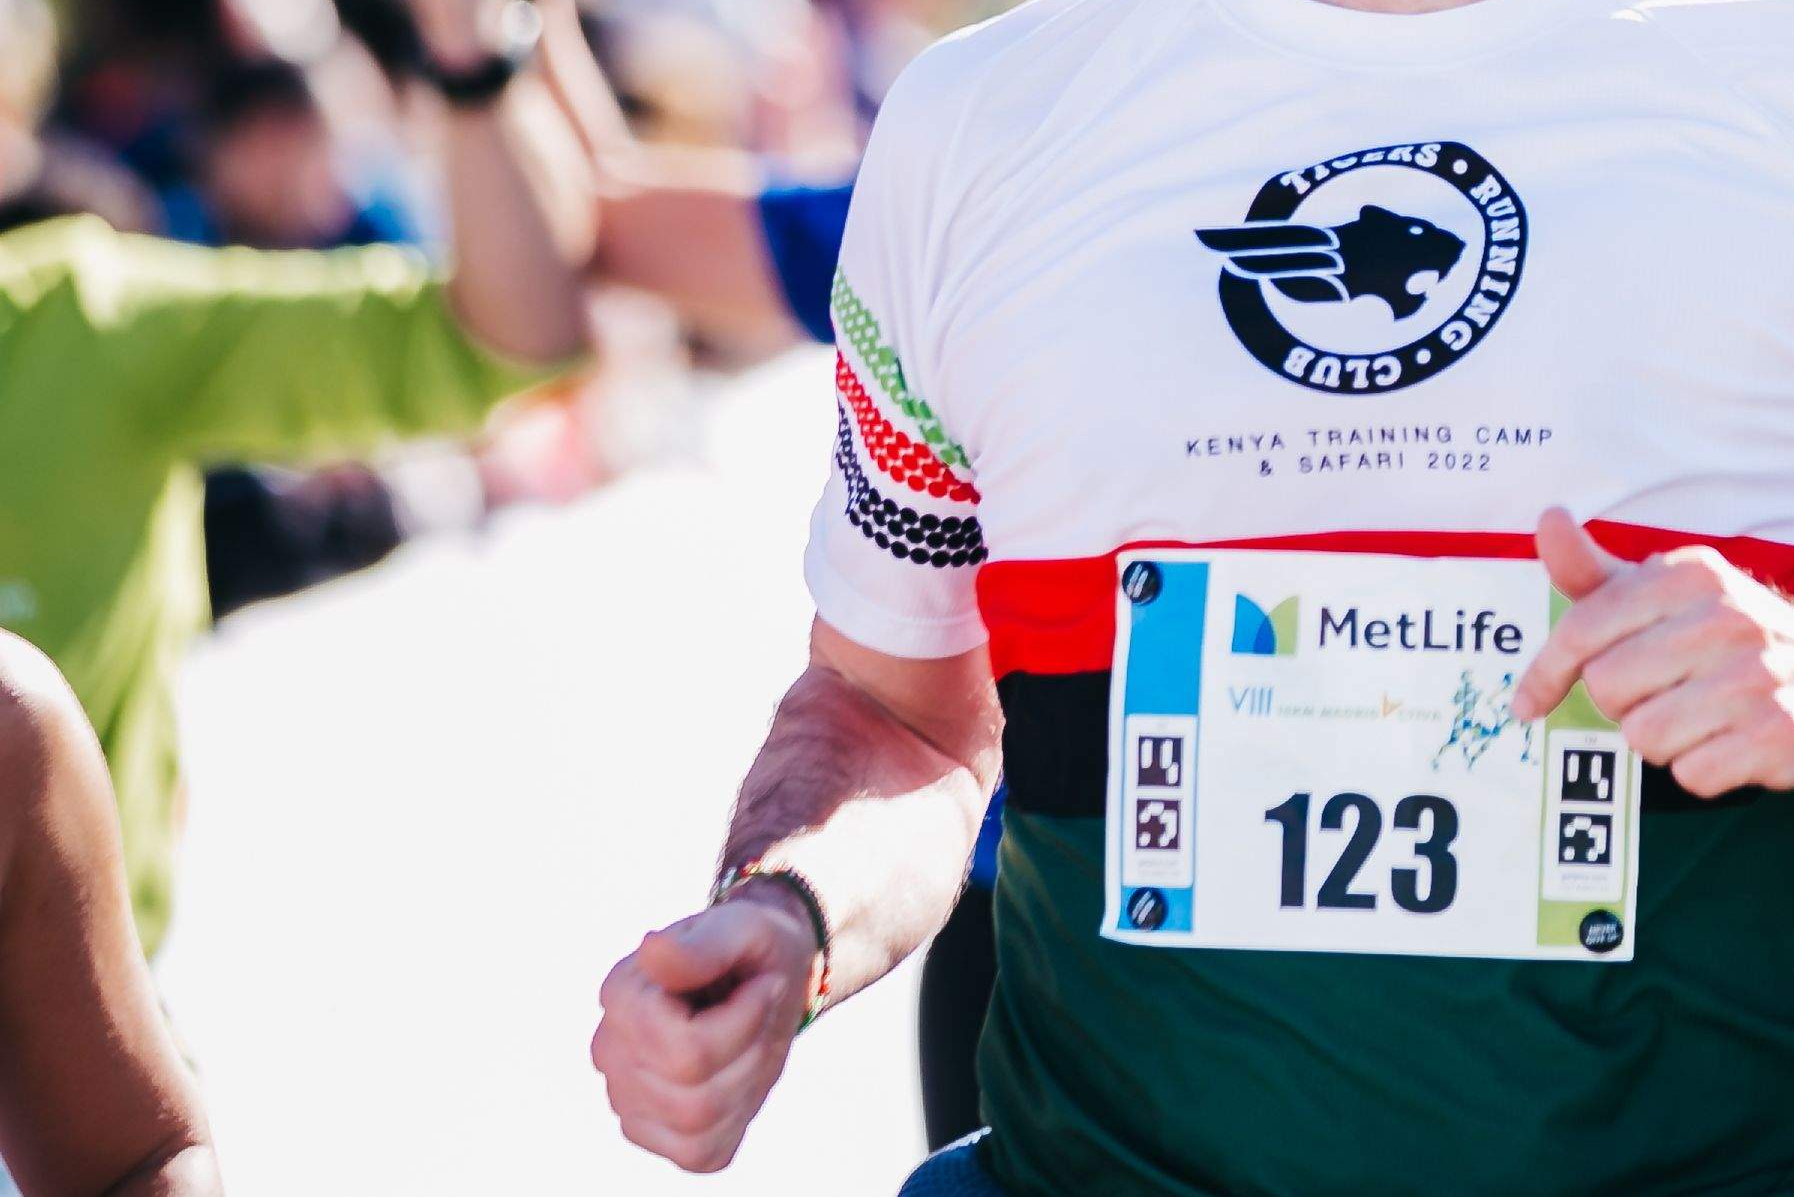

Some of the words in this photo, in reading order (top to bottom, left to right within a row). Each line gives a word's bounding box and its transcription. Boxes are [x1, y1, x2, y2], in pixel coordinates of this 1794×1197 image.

[1440, 174, 1520, 352] RUNNING
[1282, 346, 1402, 389] CLUB
[1185, 433, 1287, 457] KENYA
[1307, 426, 1453, 446] TRAINING
[1475, 426, 1553, 446] CAMP
[1259, 459, 1273, 476] &
[1299, 452, 1405, 474] SAFARI
[1427, 453, 1492, 471] 2022
[1319, 607, 1523, 654] MetLife
[1228, 685, 1274, 718] VIII
[1263, 791, 1459, 914] 123
